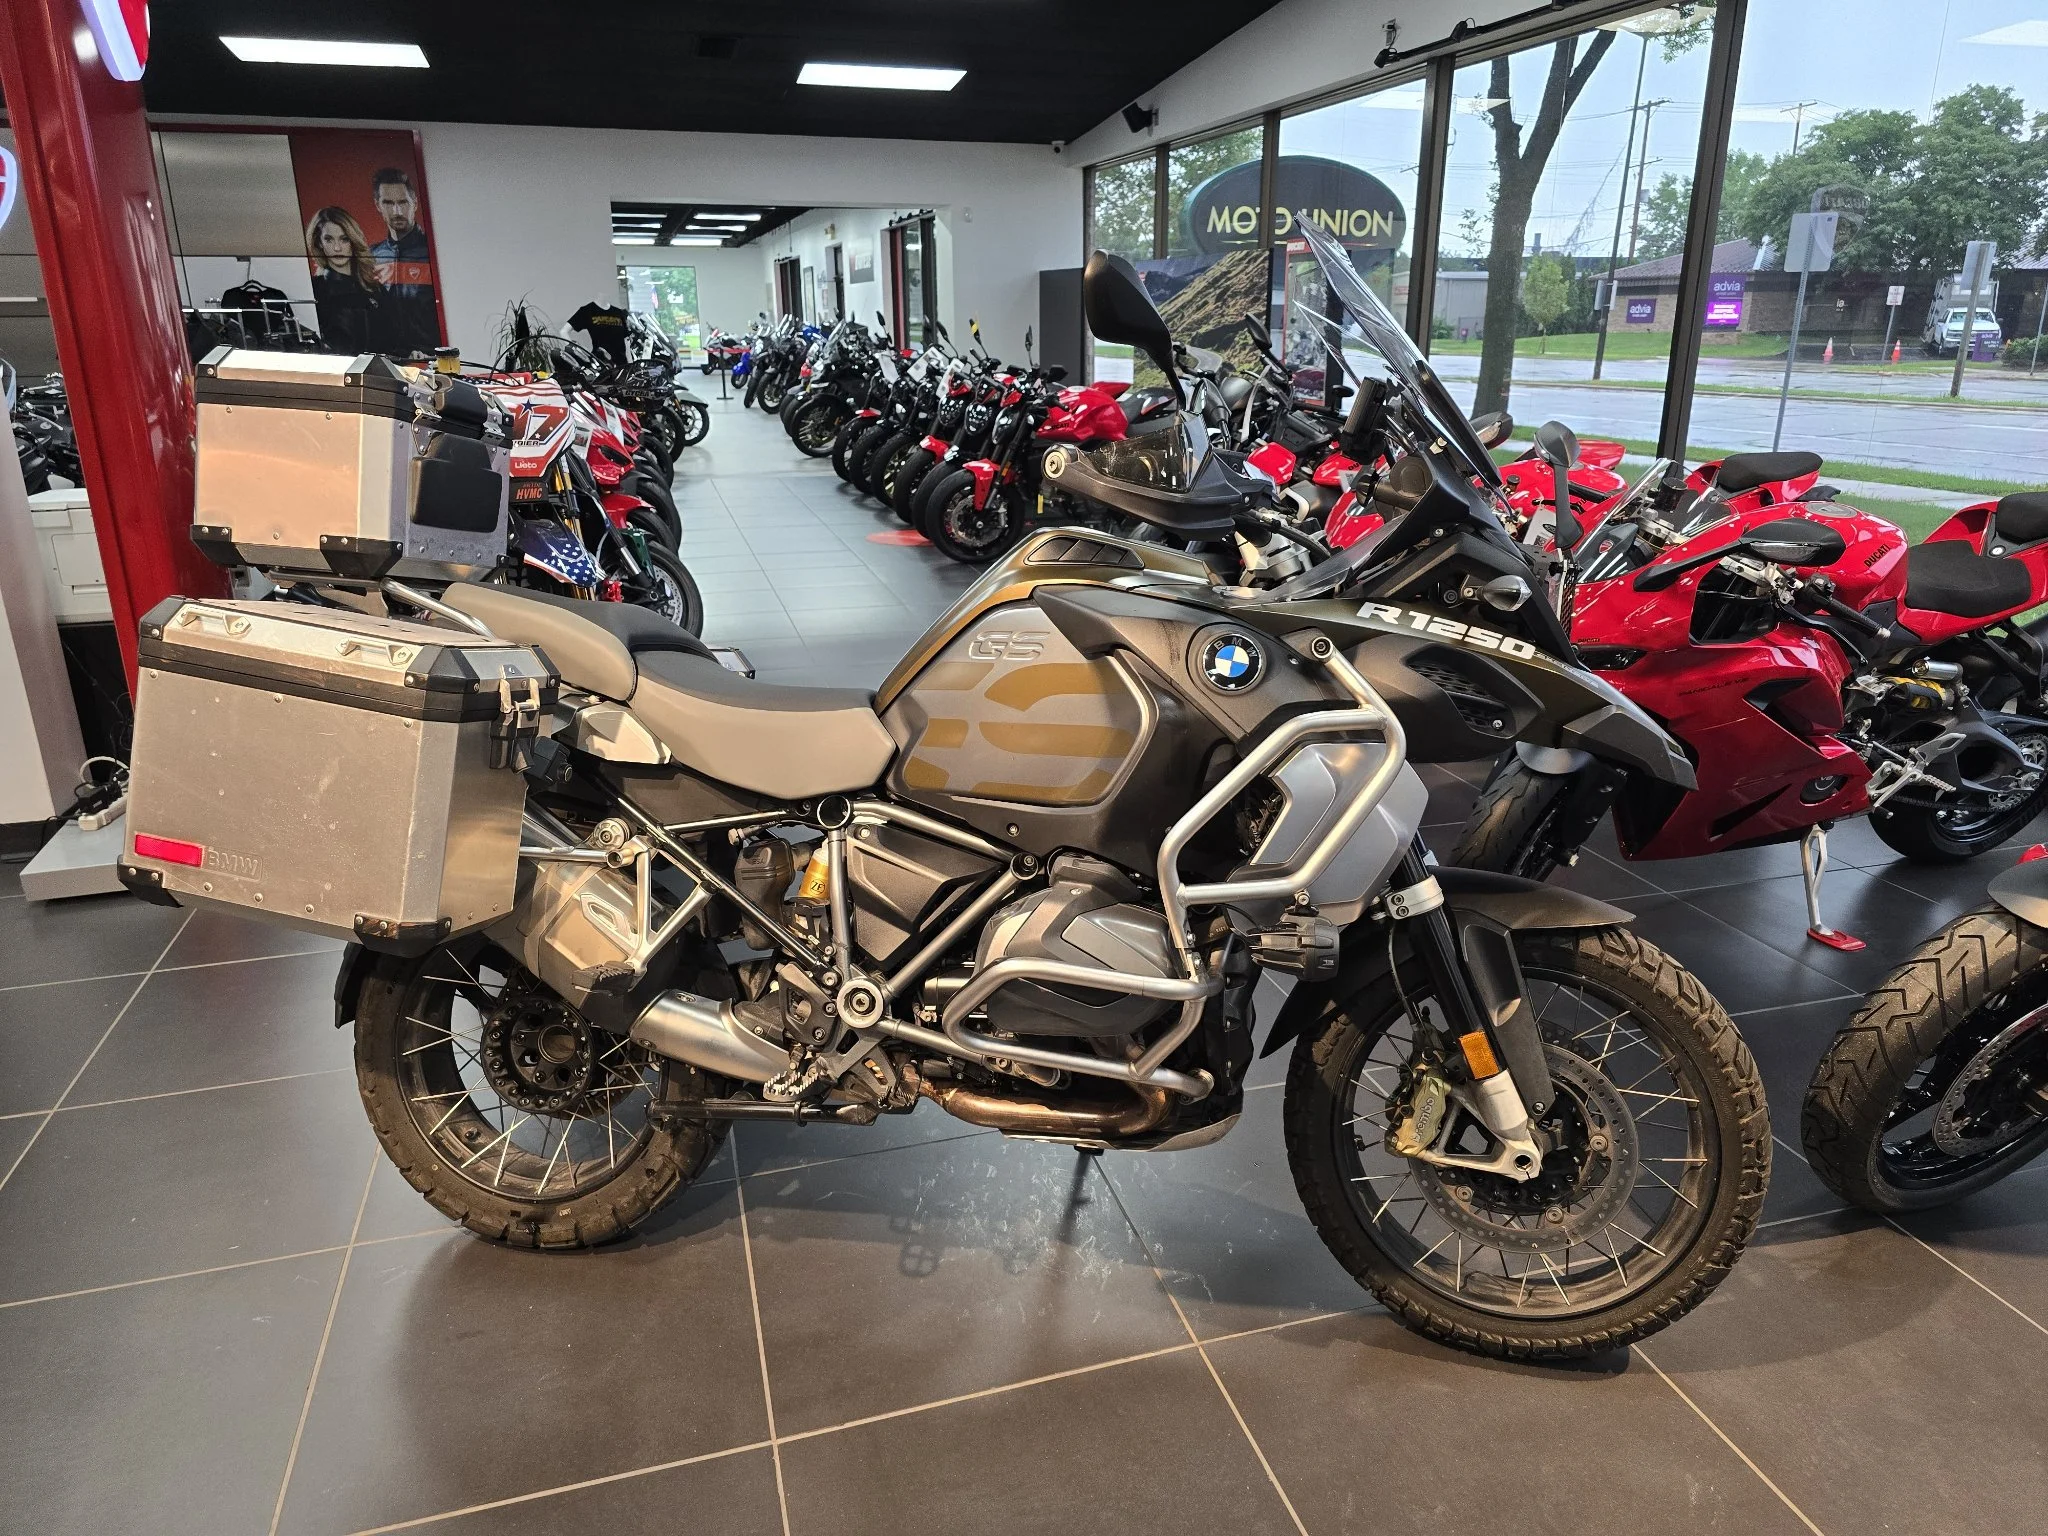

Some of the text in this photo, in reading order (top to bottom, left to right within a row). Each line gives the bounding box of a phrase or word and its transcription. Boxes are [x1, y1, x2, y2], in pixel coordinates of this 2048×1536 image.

[1206, 205, 1293, 236] MOO
[1713, 280, 1741, 292] advia
[1629, 303, 1652, 314] advia
[515, 486, 543, 500] HVMC
[1863, 543, 1891, 568] DUCATI
[1356, 601, 1536, 660] R 1250
[968, 628, 1051, 661] GS
[1213, 636, 1258, 658] BMW
[208, 848, 259, 876] BMW
[810, 879, 826, 892] ZF
[1411, 1096, 1435, 1144] brembo
